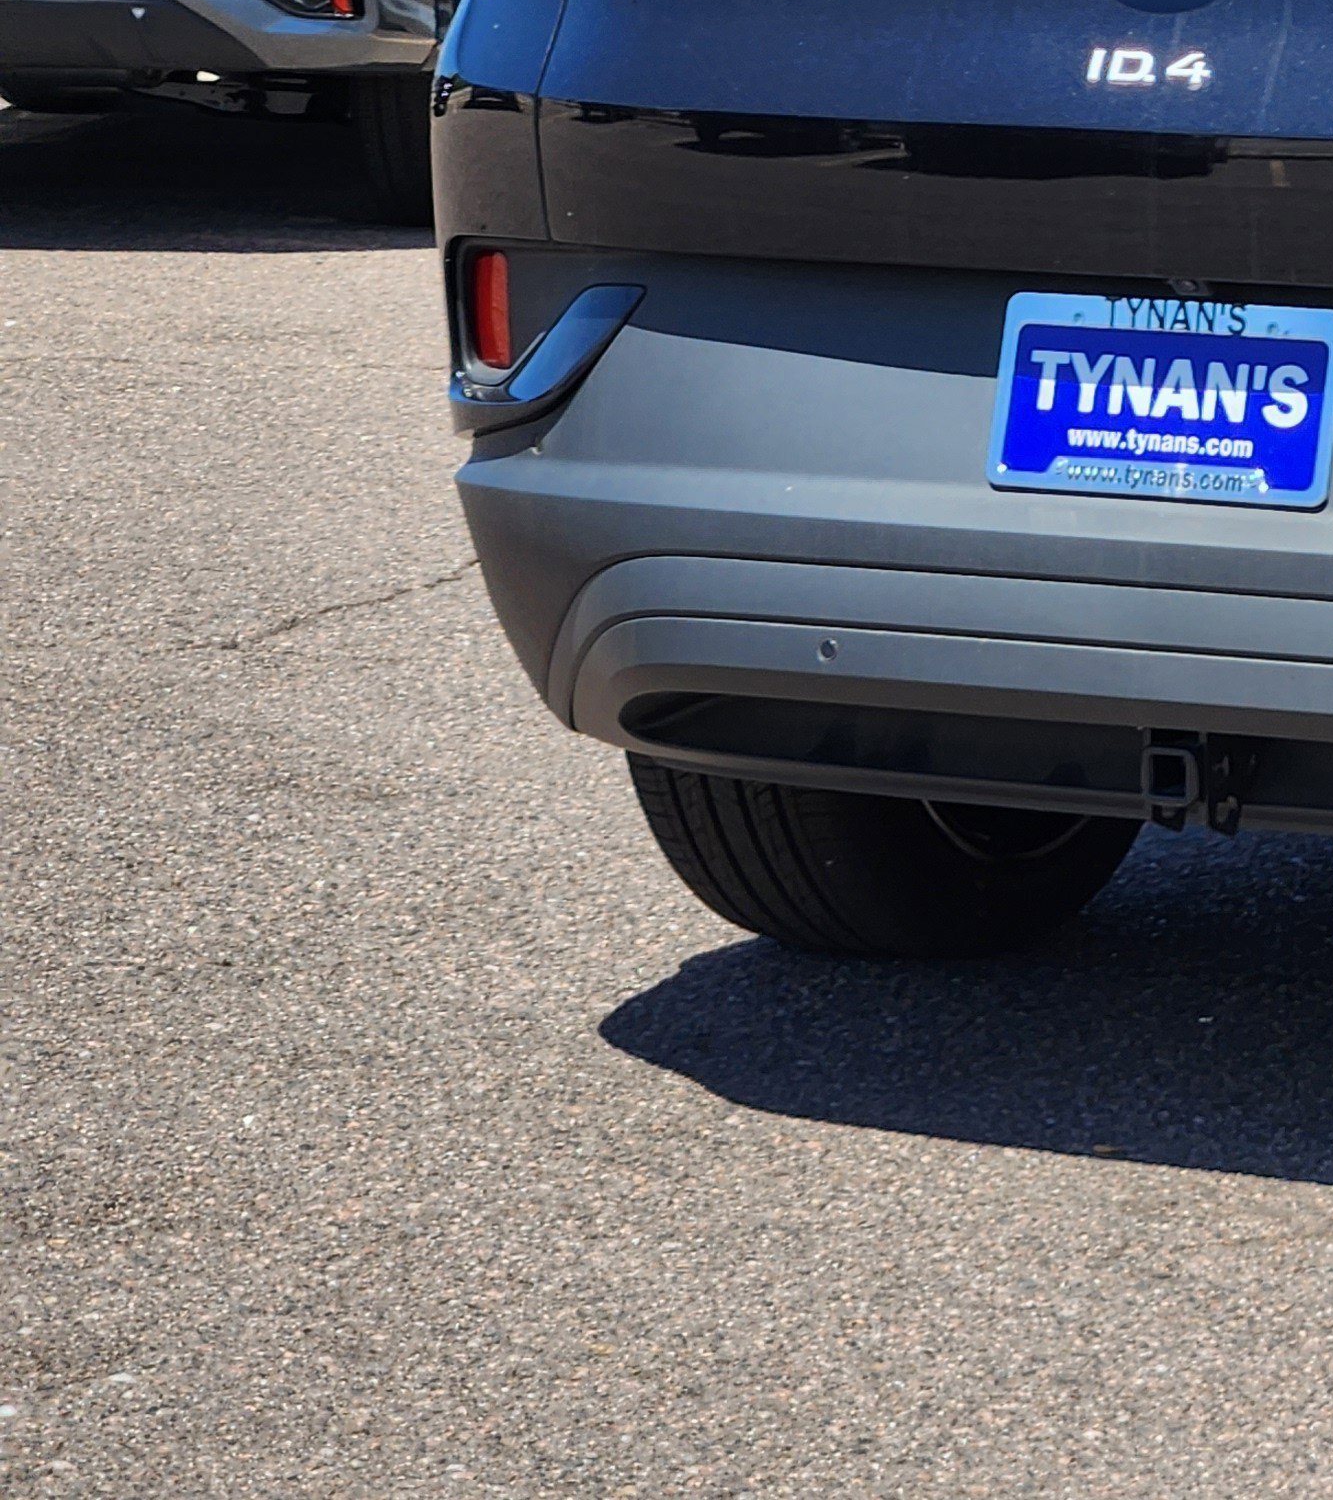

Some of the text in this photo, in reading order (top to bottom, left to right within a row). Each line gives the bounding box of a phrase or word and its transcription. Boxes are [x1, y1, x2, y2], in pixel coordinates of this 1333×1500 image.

[1104, 297, 1248, 335] TYNAN'S
[1030, 349, 1310, 428] TYNAN'S
[1067, 428, 1254, 460] www.tynans.com
[1065, 462, 1245, 493] www.tynans.com
